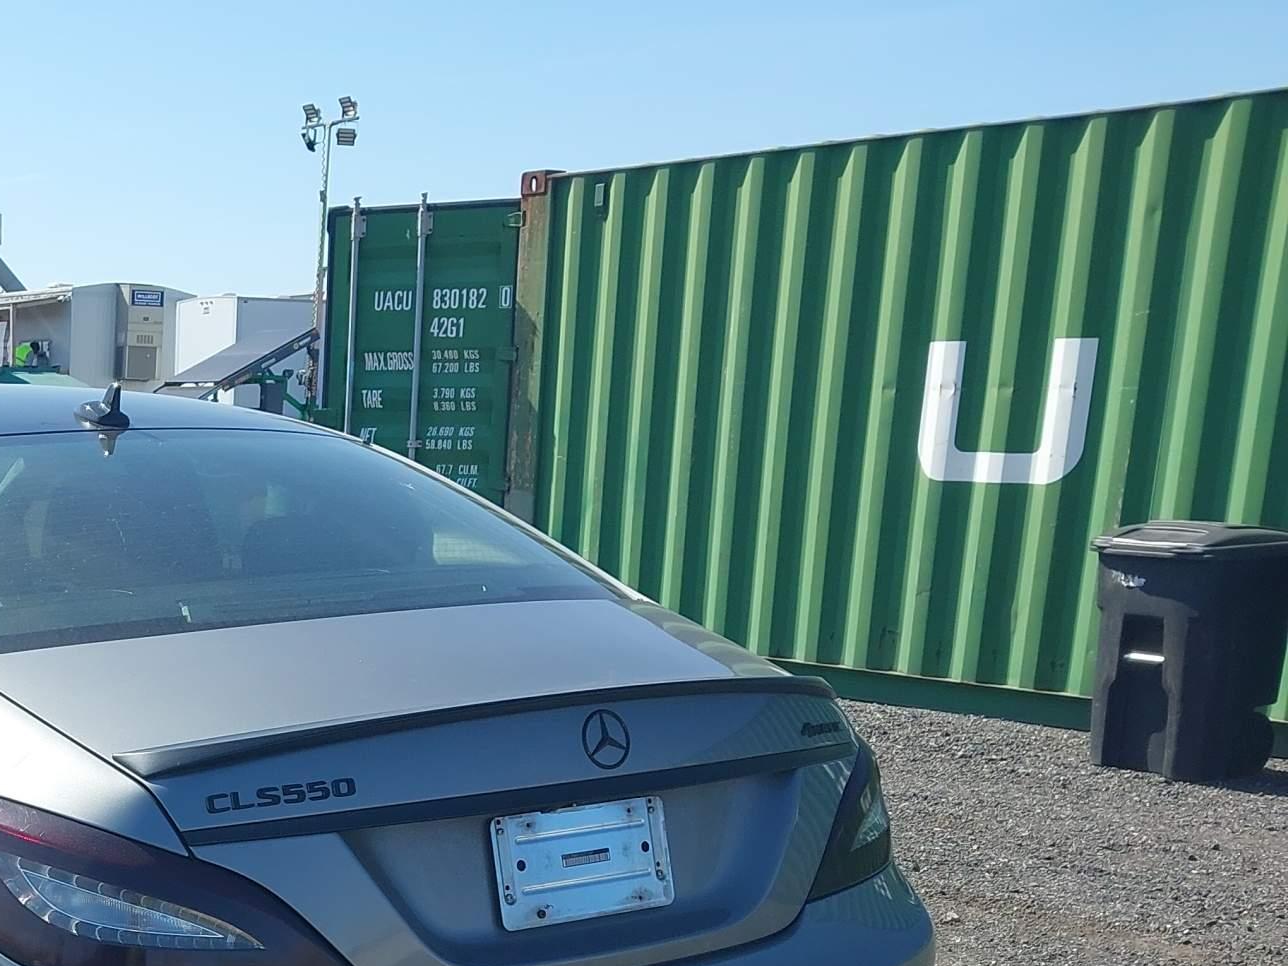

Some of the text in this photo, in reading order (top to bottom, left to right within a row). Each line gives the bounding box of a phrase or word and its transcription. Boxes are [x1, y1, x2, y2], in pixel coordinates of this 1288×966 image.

[374, 286, 512, 312] UACU 830182 0
[429, 316, 465, 338] 42G1
[364, 351, 414, 371] MAX.GROSS
[463, 349, 480, 359] KGS
[432, 362, 480, 373] 67.200 LBS
[361, 389, 384, 409] TARE
[433, 387, 476, 399] 3.790 KGS
[460, 401, 477, 411] LBS
[917, 337, 1099, 485] U
[458, 426, 476, 437] KGS
[457, 440, 473, 450] LBS
[205, 777, 357, 815] CLS550
